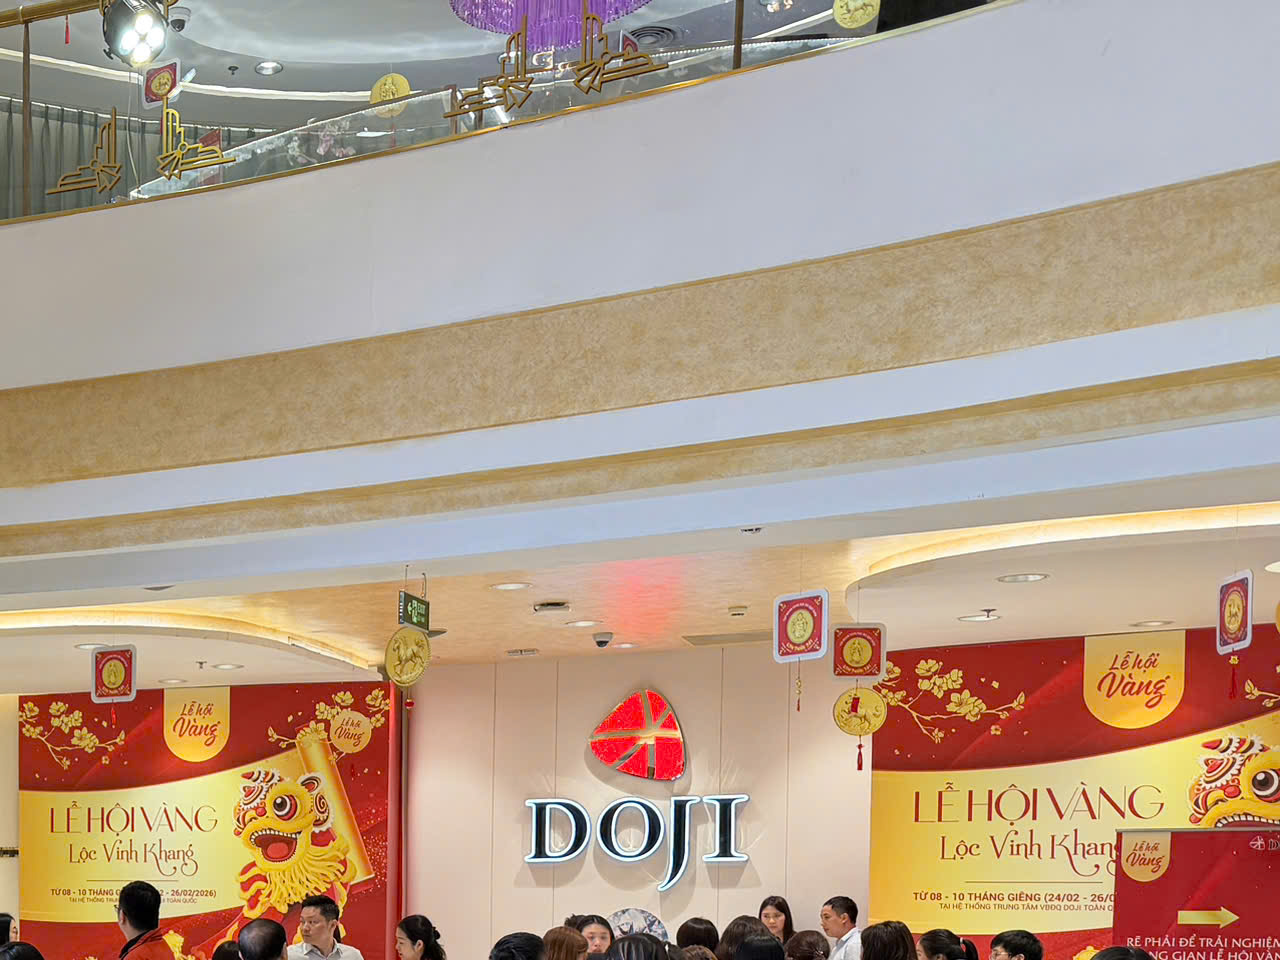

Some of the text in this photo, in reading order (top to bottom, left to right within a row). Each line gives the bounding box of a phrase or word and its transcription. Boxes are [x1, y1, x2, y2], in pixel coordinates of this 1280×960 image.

[1109, 651, 1160, 672] Lễ hội
[1097, 672, 1170, 709] Vàng
[180, 701, 214, 719] Lễ hội
[173, 716, 220, 746] Vàng
[335, 726, 365, 747] Vàng
[913, 781, 1164, 826] LỄ HỘI VÀNG
[50, 800, 218, 837] LỄ HỘI VÀNG
[524, 794, 749, 892] DOJI
[940, 835, 980, 860] Lộc
[69, 843, 97, 863] Lộc
[144, 839, 198, 876] Khang
[1126, 852, 1165, 873] Vàng
[62, 888, 71, 896] 08
[78, 888, 87, 896] 10
[88, 887, 114, 896] THÁNG
[171, 889, 216, 898] 26/02/2026)
[930, 892, 942, 901] 08
[953, 892, 965, 901] 10
[967, 891, 1005, 902] THÁNG
[1008, 891, 1041, 902] GIÊNG
[1044, 892, 1080, 903] (24/02
[965, 902, 991, 910] THỐNG
[1144, 934, 1175, 947] PHẢI
[1180, 934, 1196, 947] ĐỂ
[1199, 934, 1228, 948] TRẢI
[1172, 951, 1206, 960] GIAN
[1210, 948, 1224, 960] LỄ
